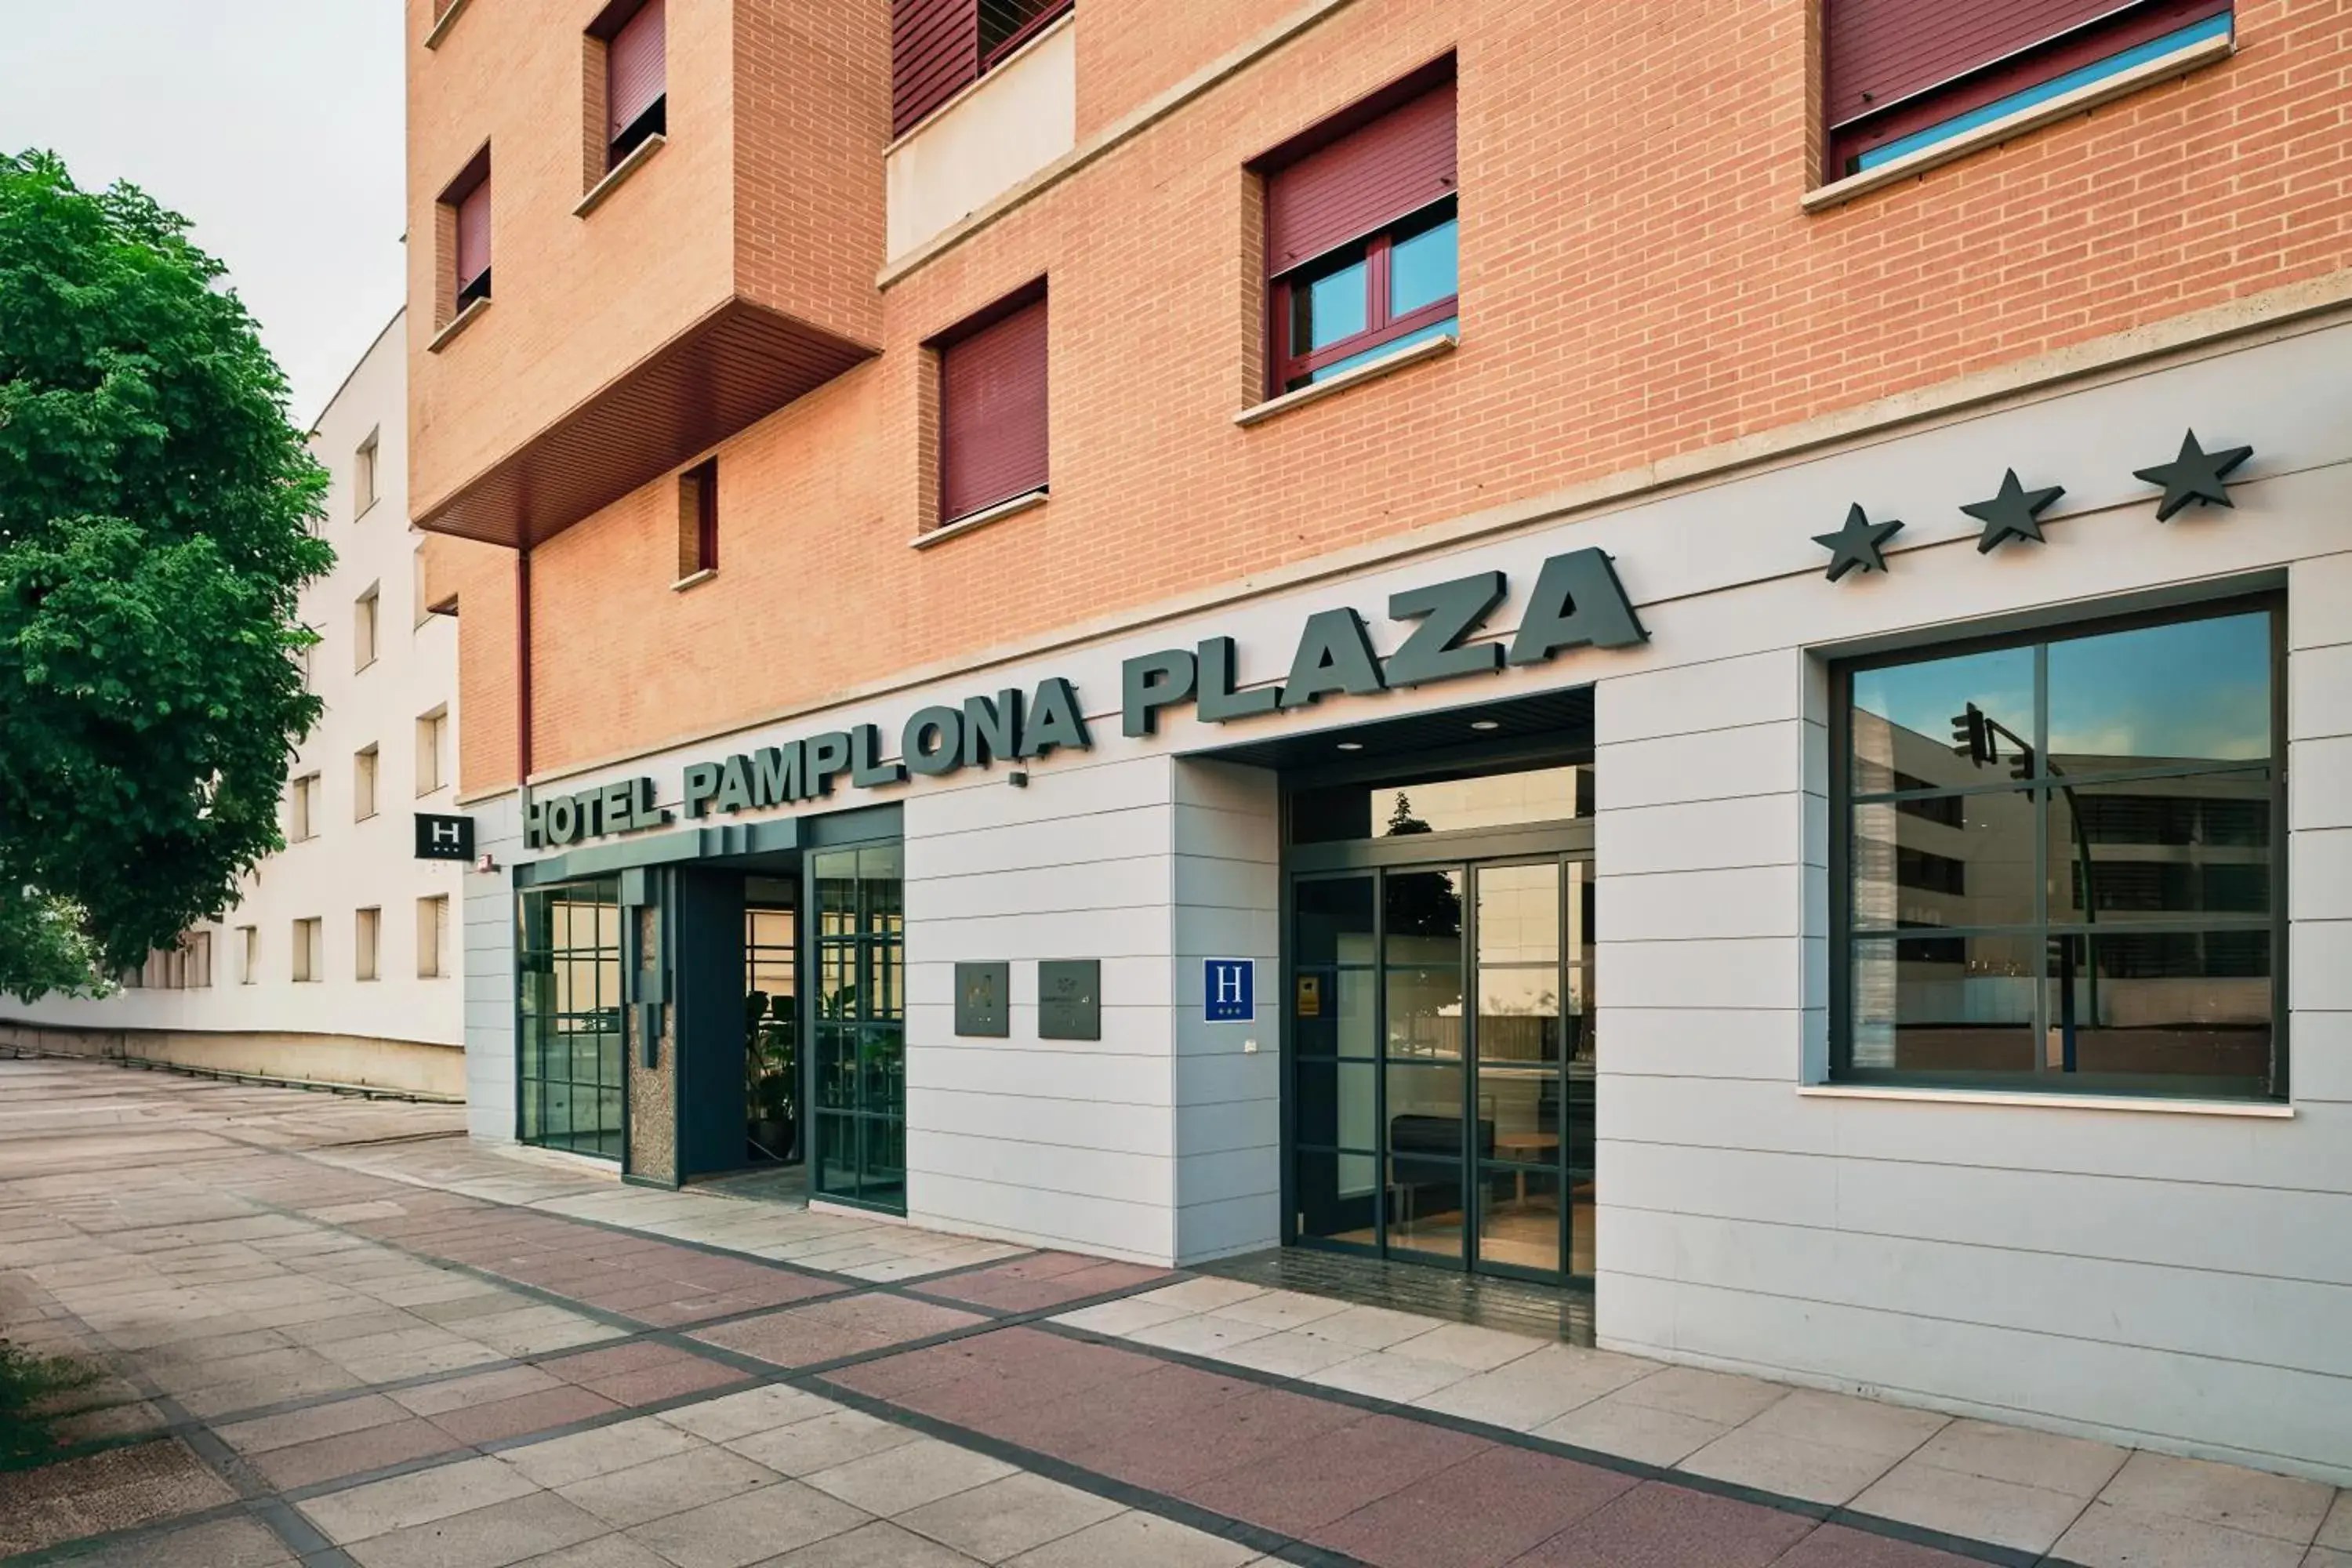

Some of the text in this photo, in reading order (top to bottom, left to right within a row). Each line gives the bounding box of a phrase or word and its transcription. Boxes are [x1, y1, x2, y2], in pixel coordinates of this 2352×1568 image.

[524, 546, 1650, 849] HOTEL PAMPLONA PLAZA
[432, 821, 460, 844] H
[1217, 966, 1243, 1003] H
